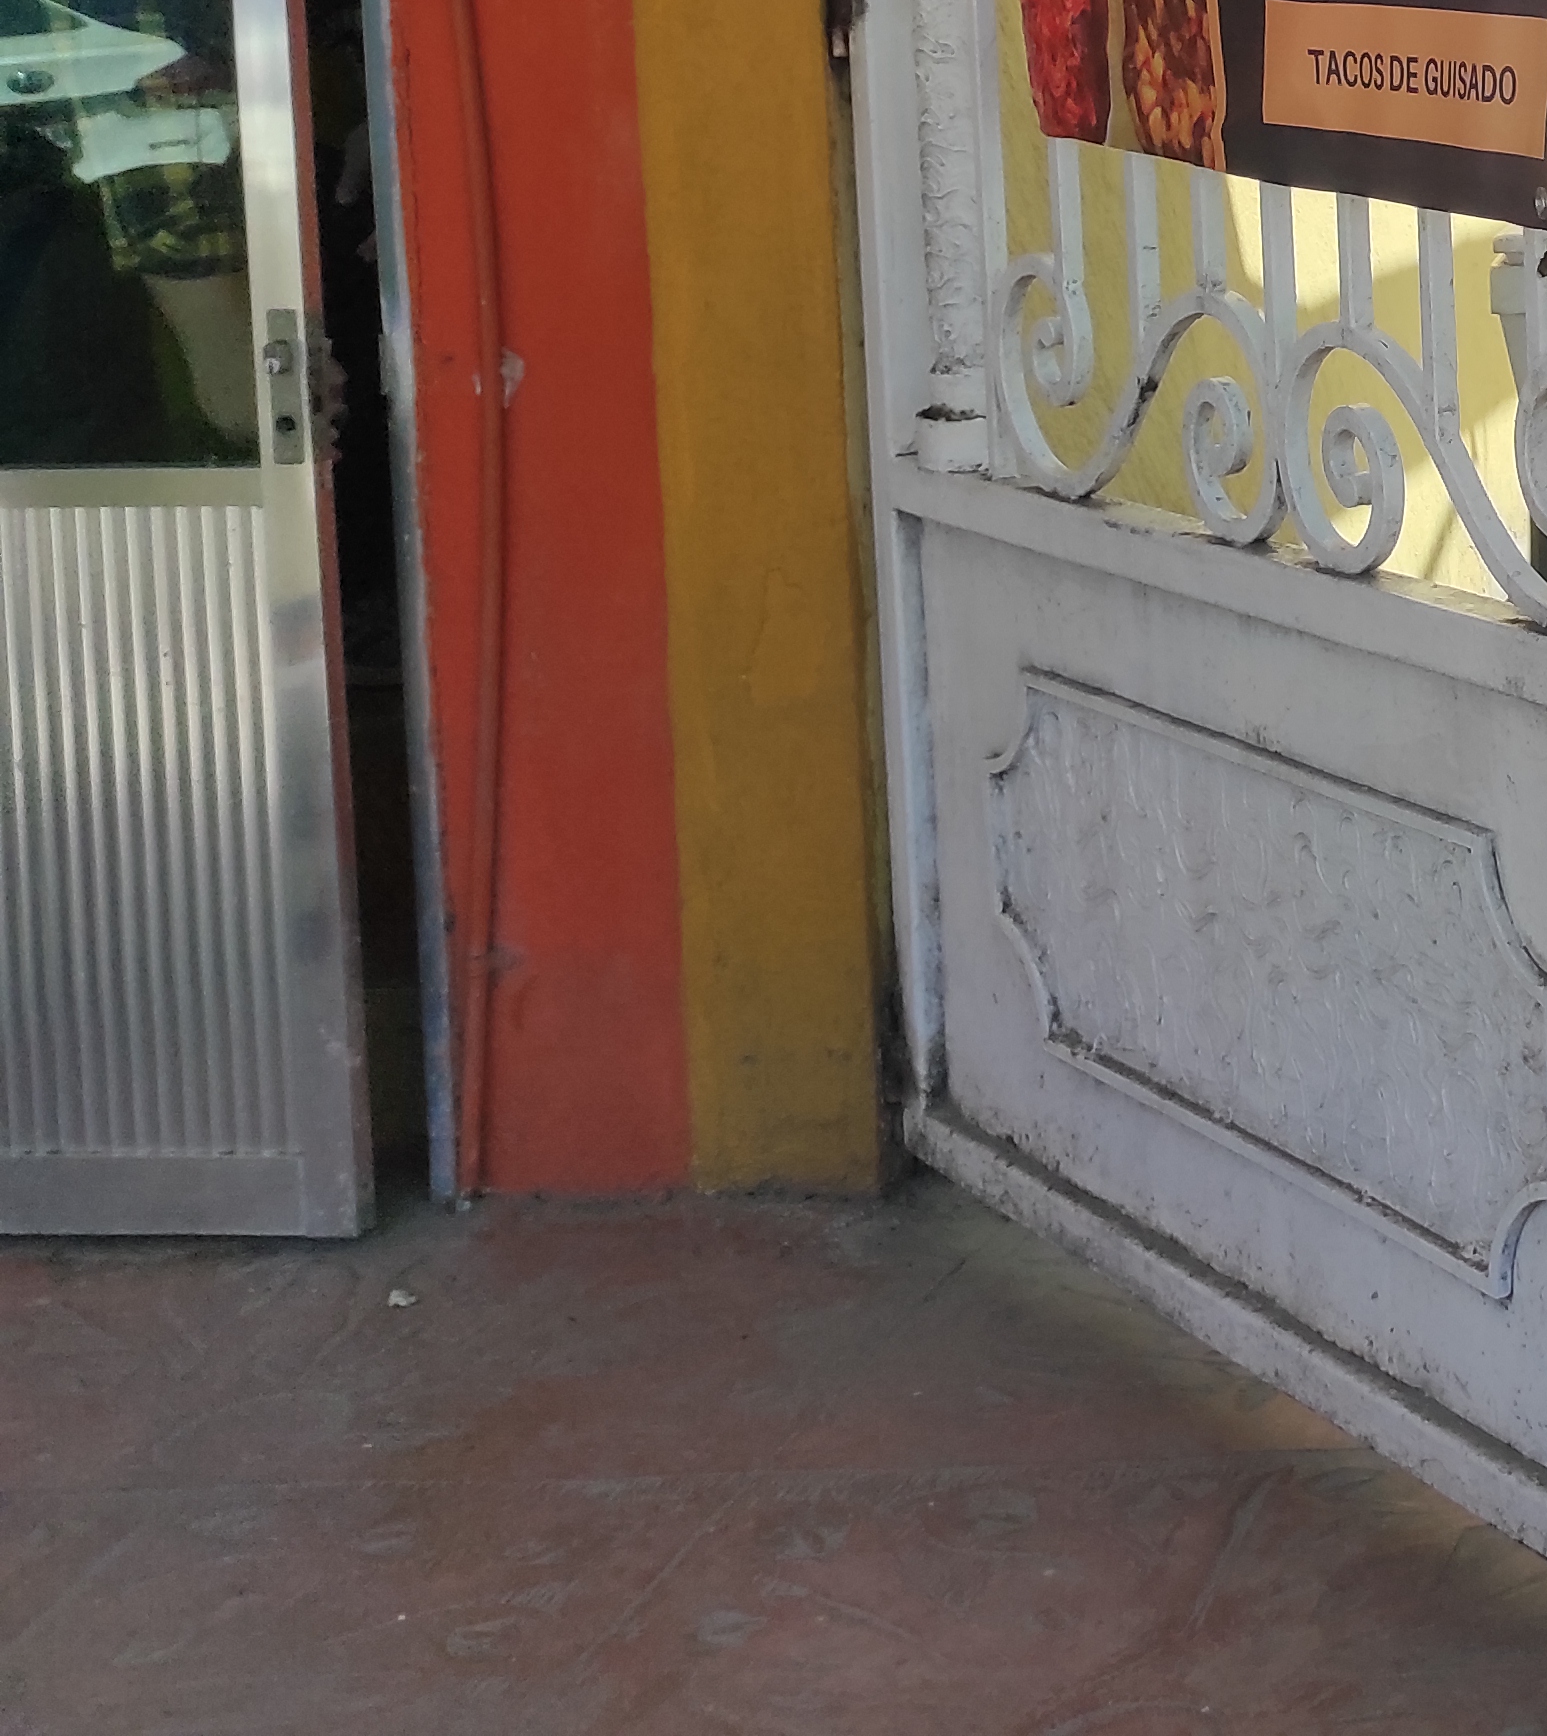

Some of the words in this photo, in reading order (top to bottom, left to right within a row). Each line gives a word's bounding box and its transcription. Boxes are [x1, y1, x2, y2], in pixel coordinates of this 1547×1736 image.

[1308, 48, 1386, 91] TACOS
[1389, 54, 1421, 95] DE
[1424, 57, 1517, 106] GUISADO
